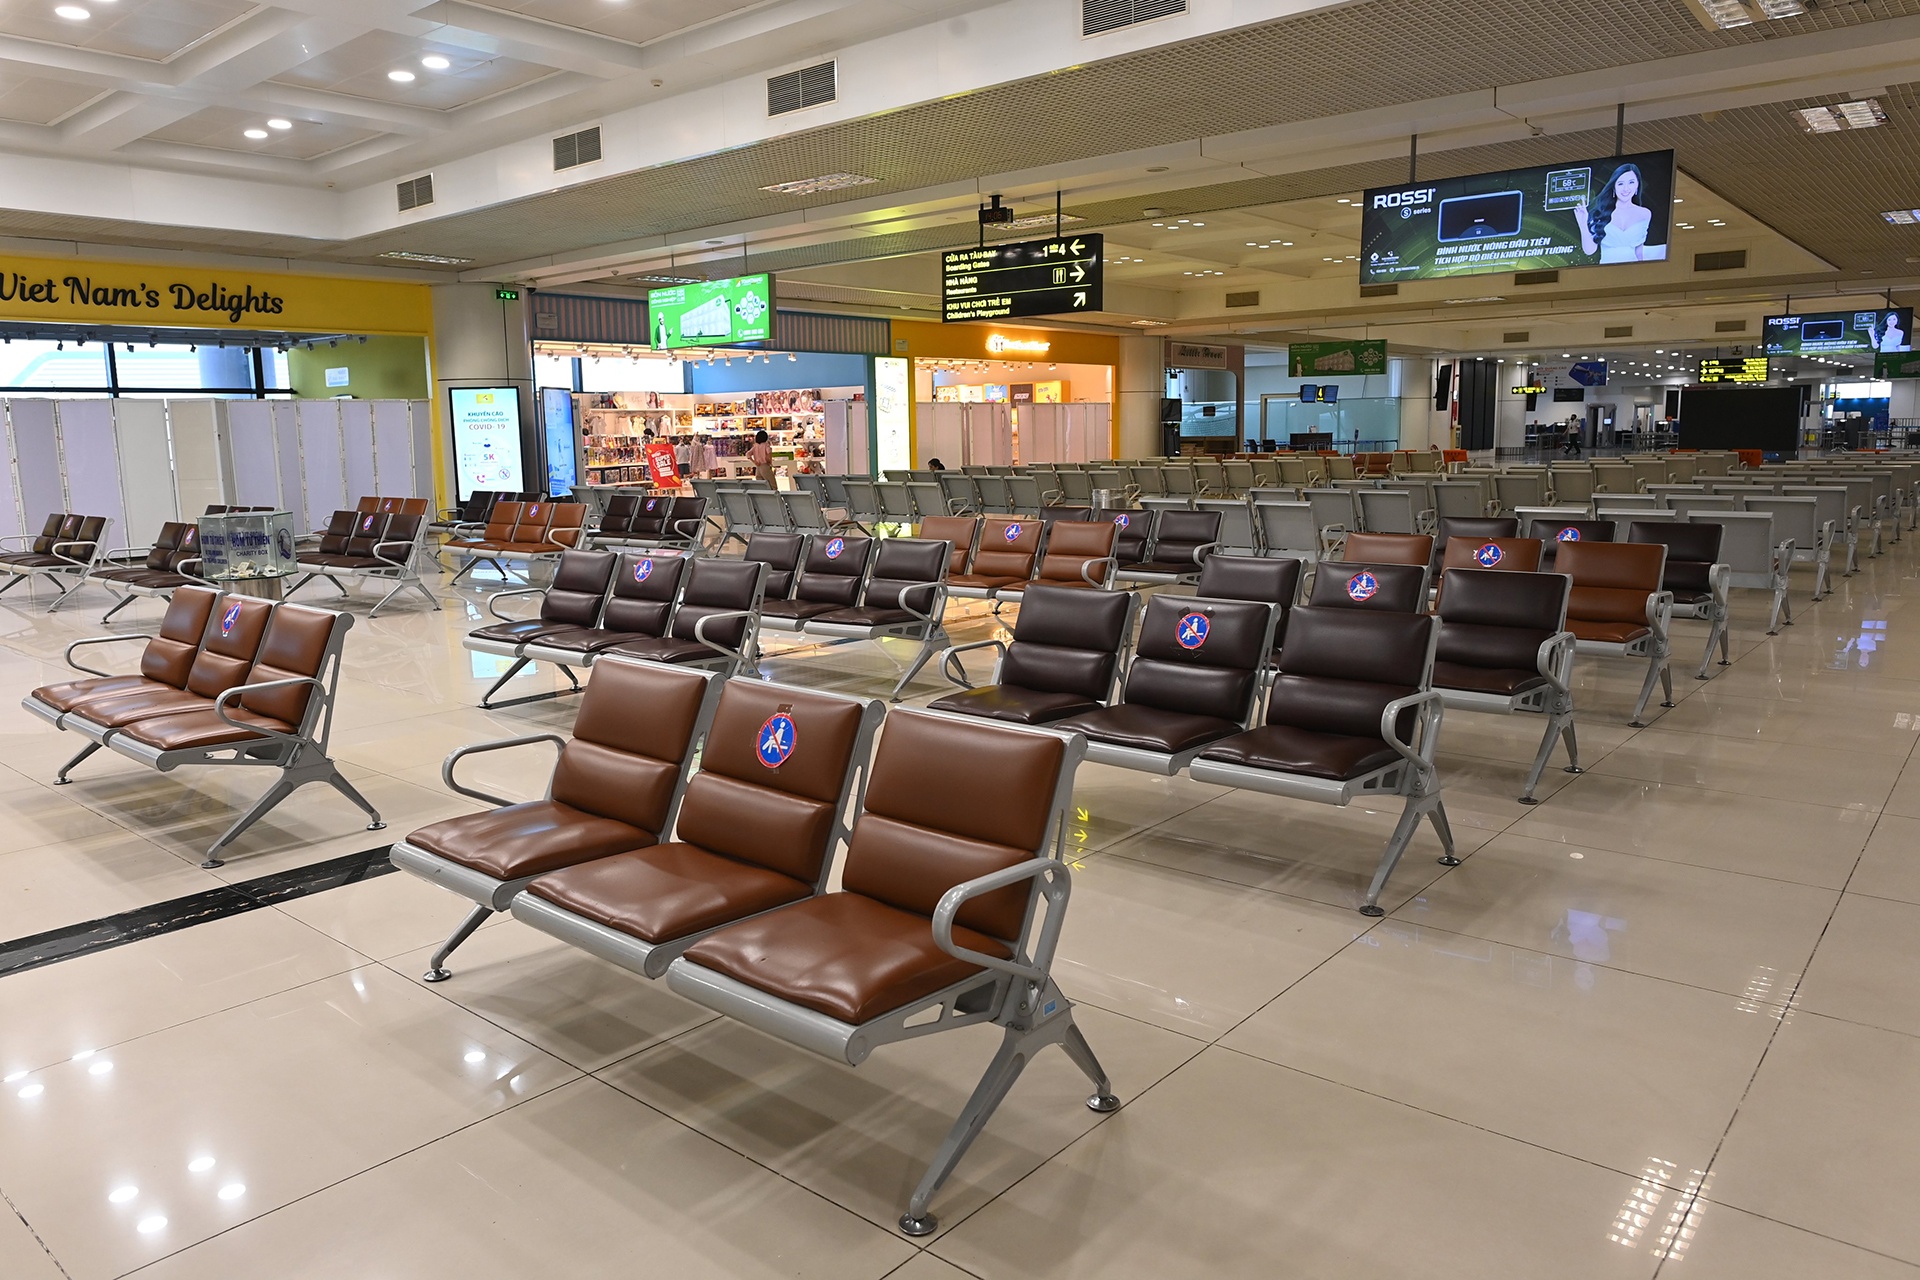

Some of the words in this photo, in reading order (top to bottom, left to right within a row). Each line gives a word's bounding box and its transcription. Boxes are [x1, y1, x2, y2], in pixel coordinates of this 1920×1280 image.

[1413, 207, 1432, 215] series
[1059, 243, 1066, 255] 4
[959, 253, 969, 262] RA
[0, 273, 59, 303] Viet
[63, 276, 160, 308] Nam's
[169, 282, 283, 323] Delights
[1001, 297, 1012, 305] EM
[946, 310, 976, 319] Children's
[976, 307, 1010, 318] Playground
